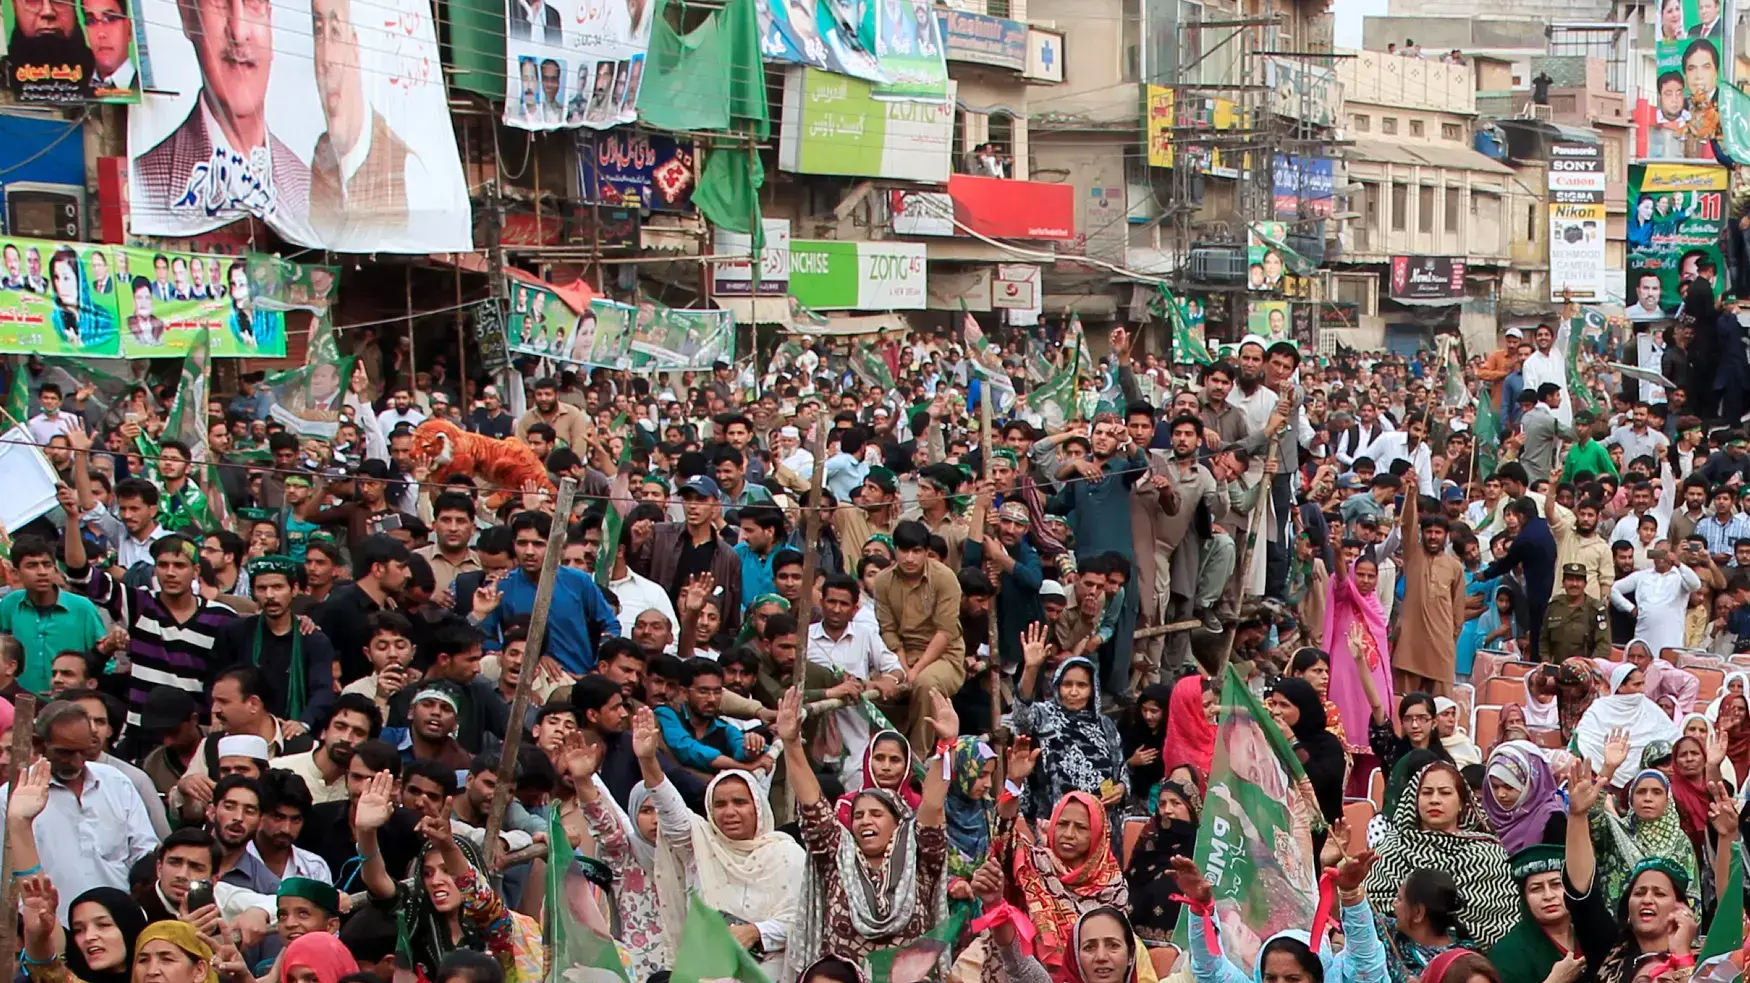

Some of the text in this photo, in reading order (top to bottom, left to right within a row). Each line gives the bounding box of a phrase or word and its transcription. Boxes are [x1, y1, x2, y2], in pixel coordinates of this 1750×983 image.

[1552, 145, 1597, 156] Panasonic
[1553, 160, 1597, 170] SONY
[1556, 176, 1595, 186] Canon
[1556, 191, 1594, 202] SIGMA
[1556, 205, 1596, 217] Nikon
[1699, 192, 1721, 220] 11
[1552, 250, 1600, 258] MEHMOOD
[790, 252, 829, 274] NCHISE
[909, 257, 921, 273] 4G
[1557, 261, 1596, 269] CAMERA
[1560, 270, 1595, 279] CENTER
